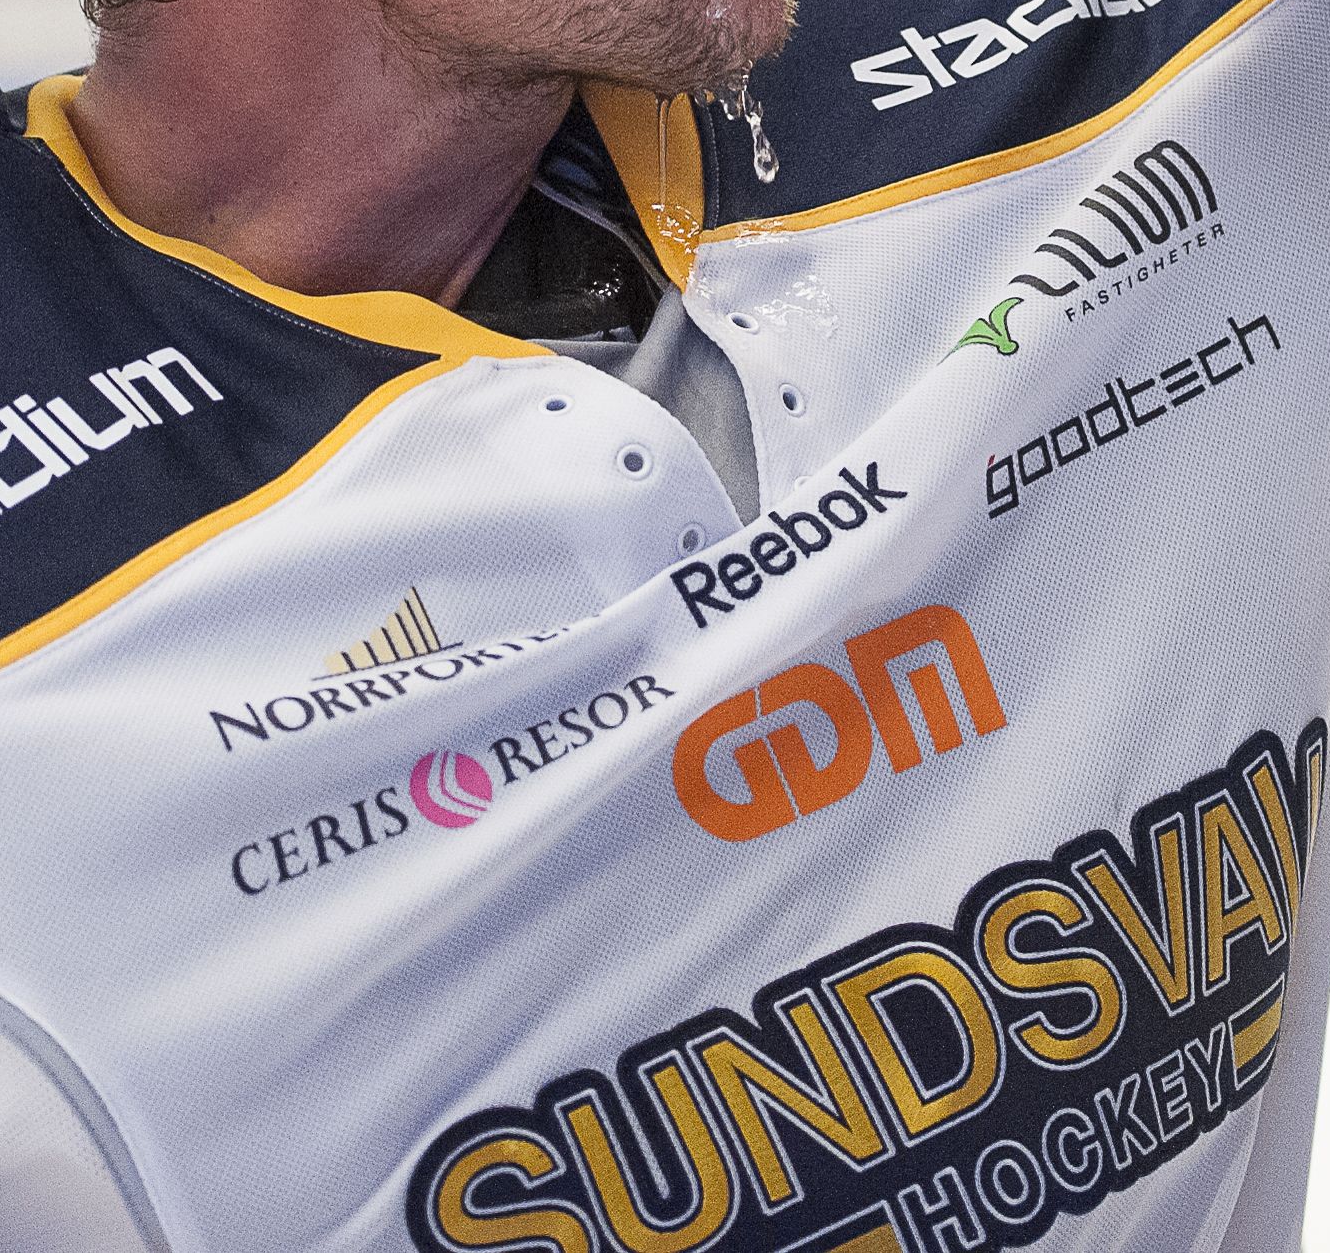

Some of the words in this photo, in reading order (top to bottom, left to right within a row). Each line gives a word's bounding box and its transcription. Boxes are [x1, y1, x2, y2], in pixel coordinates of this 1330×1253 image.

[1009, 138, 1220, 299] LILIUM
[1063, 222, 1227, 323] FASTIGHETER
[983, 310, 1282, 520] goodtech
[668, 459, 909, 629] Reebok
[207, 613, 601, 752] NORRPO
[670, 602, 1009, 844] GDM
[230, 785, 411, 897] CERIS
[490, 670, 678, 787] RESOR
[898, 1021, 1228, 1253] HOCKEY
